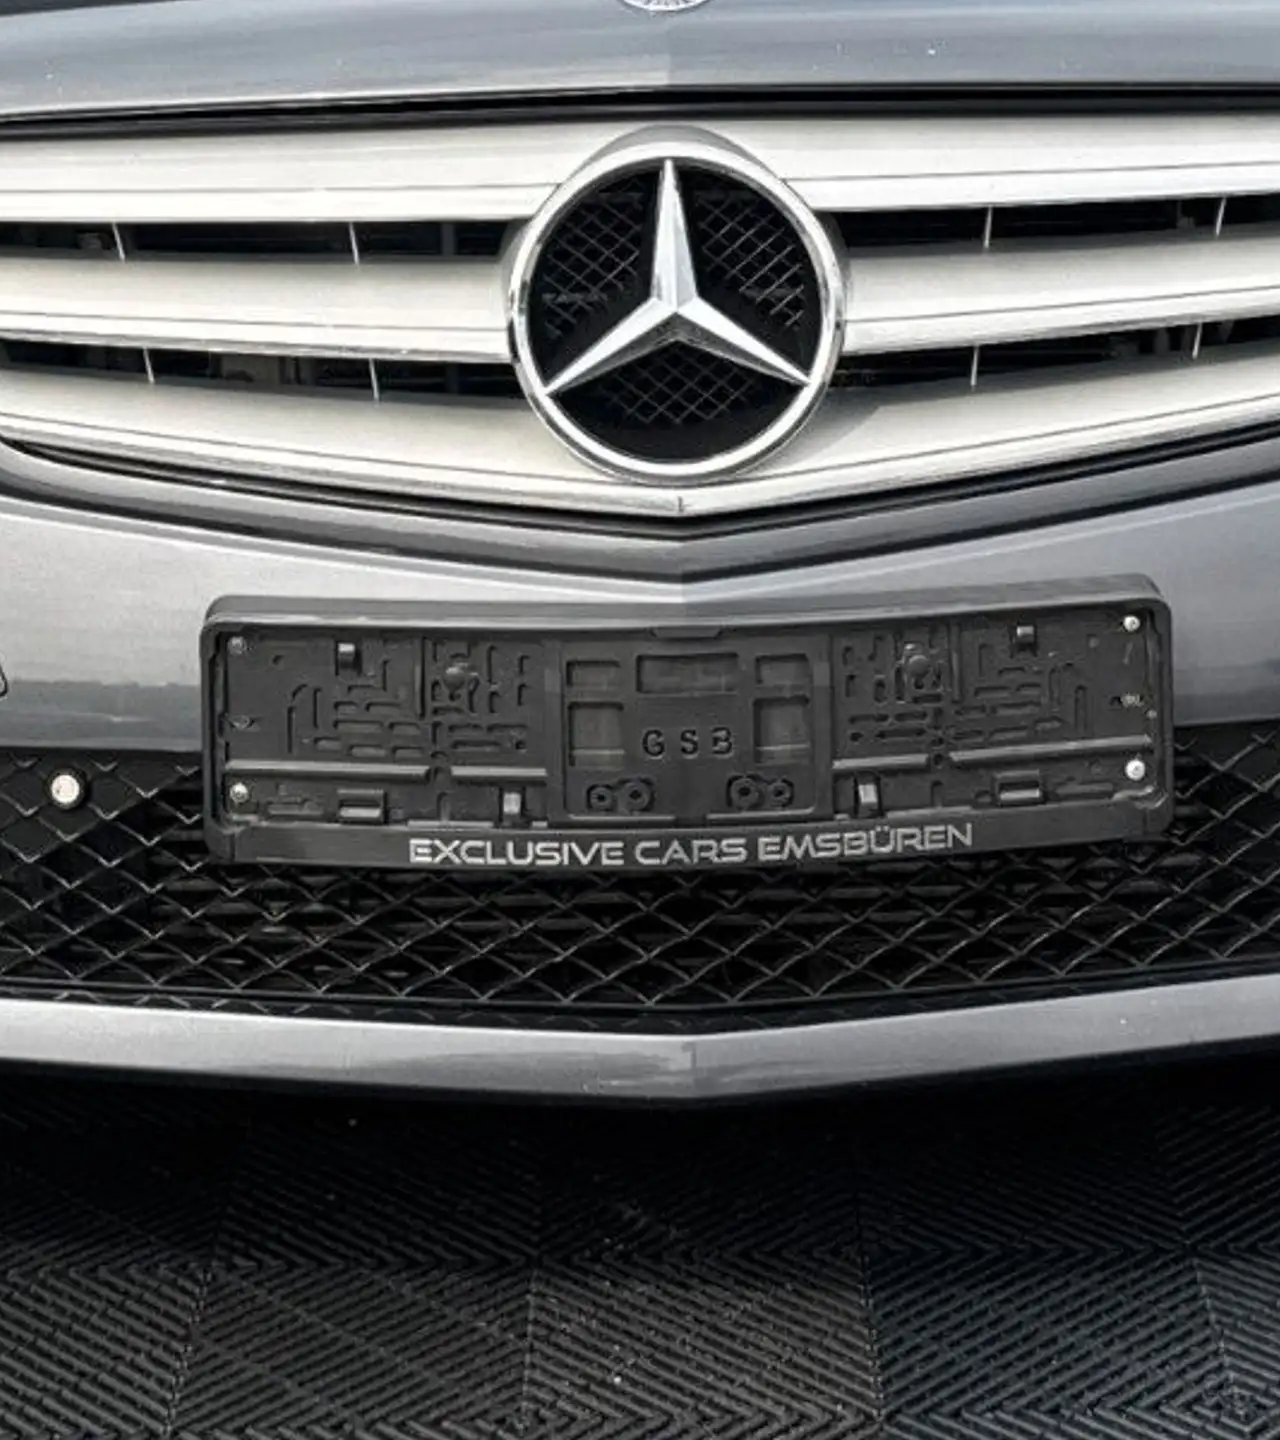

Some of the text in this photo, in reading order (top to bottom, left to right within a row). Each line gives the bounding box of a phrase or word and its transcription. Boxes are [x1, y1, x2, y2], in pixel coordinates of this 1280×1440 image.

[408, 822, 973, 866] EXCLUSIVE CARS EMSBÜREN
